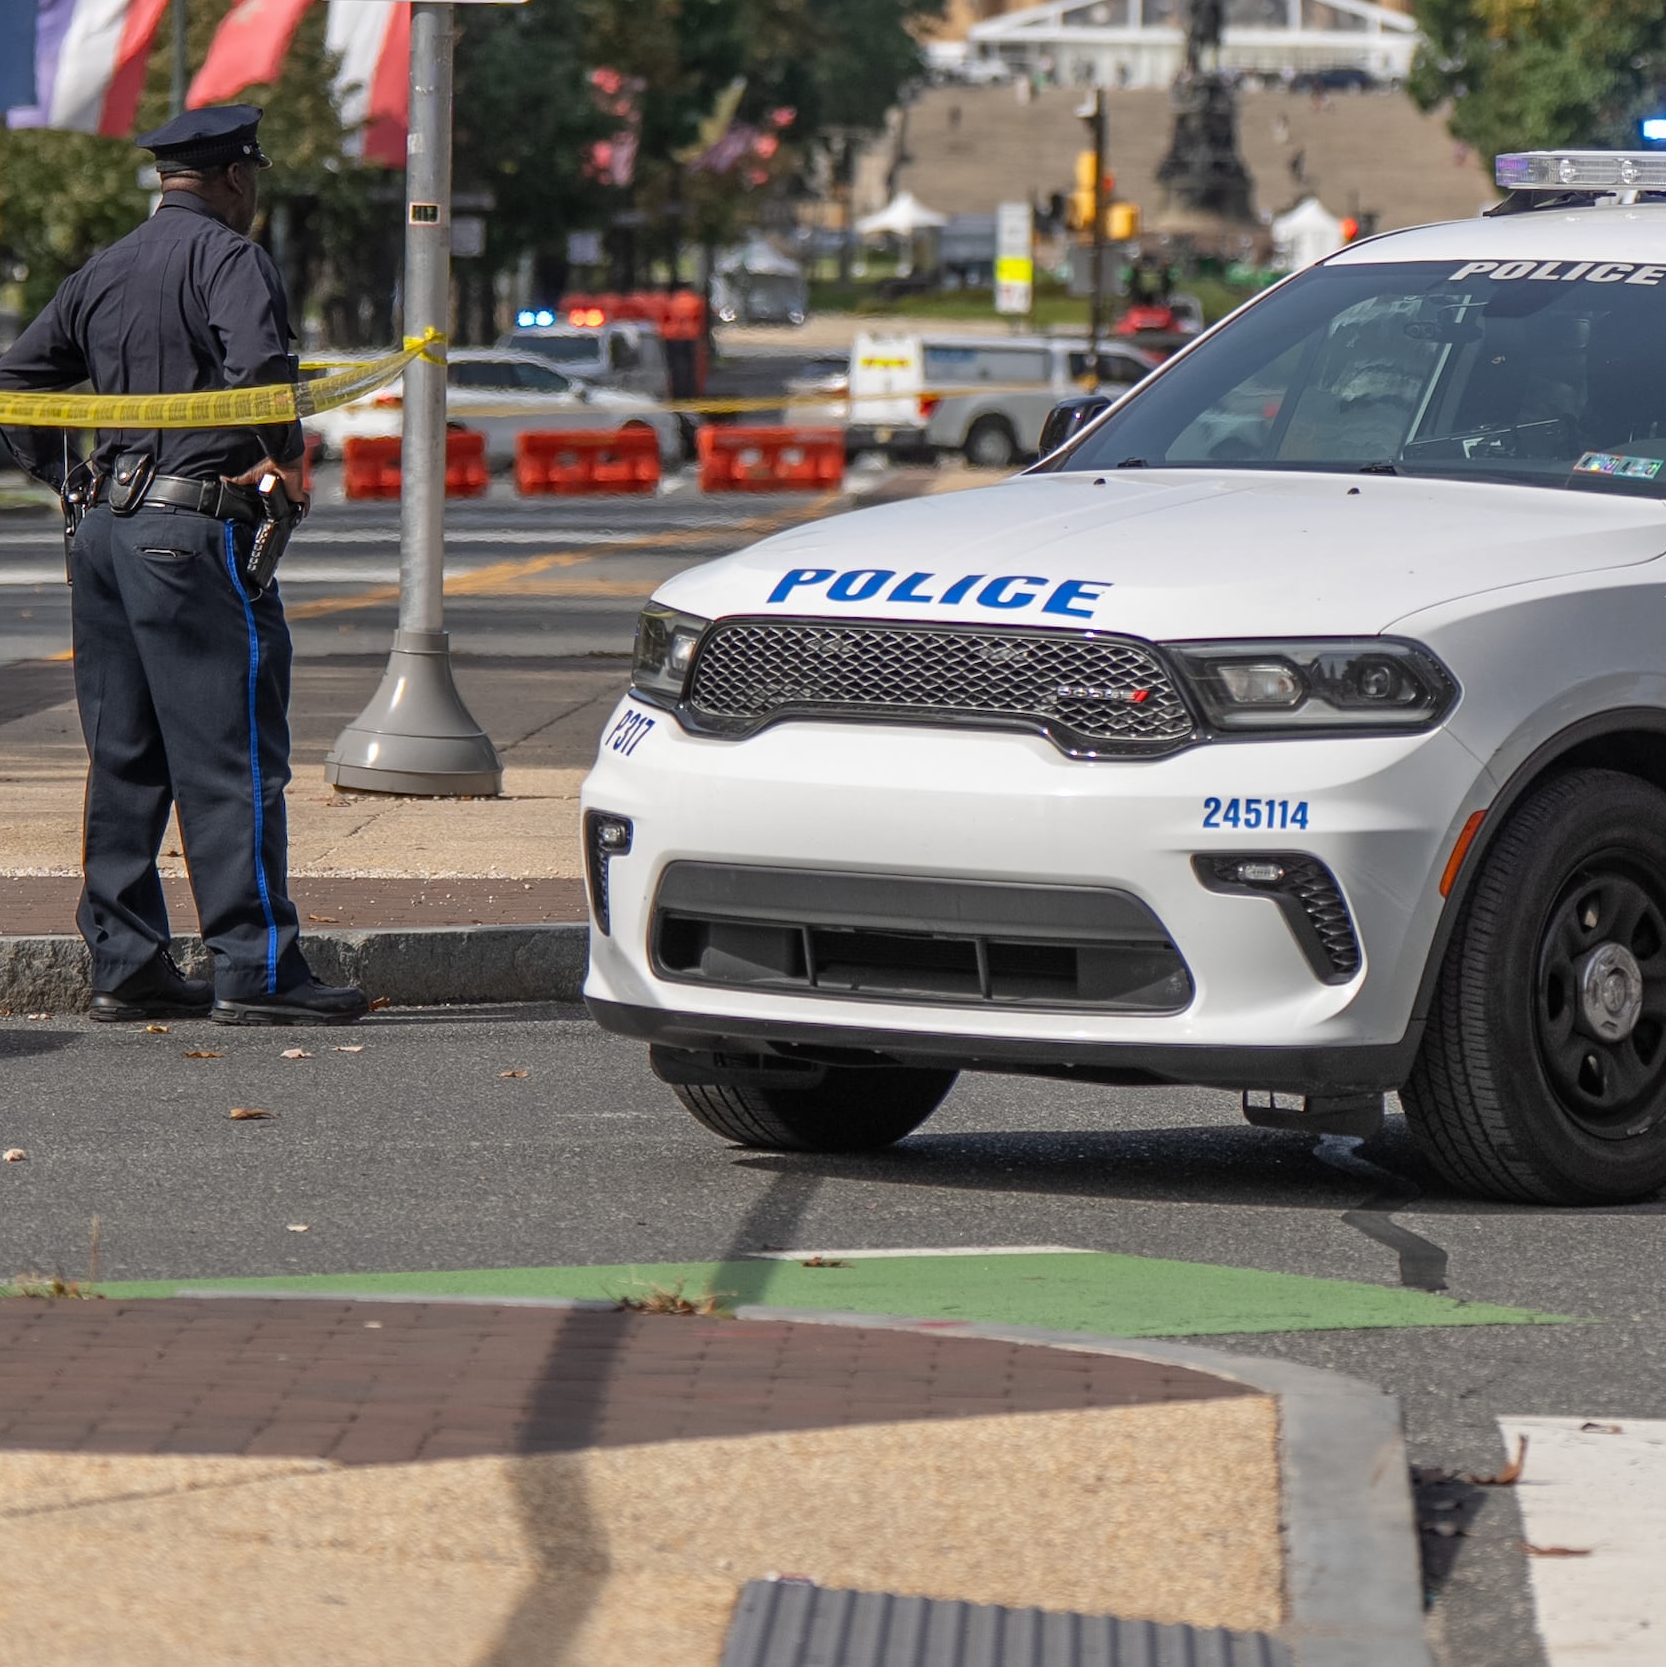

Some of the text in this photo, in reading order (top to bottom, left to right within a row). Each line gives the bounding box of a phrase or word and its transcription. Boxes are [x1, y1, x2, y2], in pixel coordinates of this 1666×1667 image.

[766, 568, 1115, 619] POLICE
[604, 709, 655, 757] P317
[1202, 797, 1309, 830] 245114
